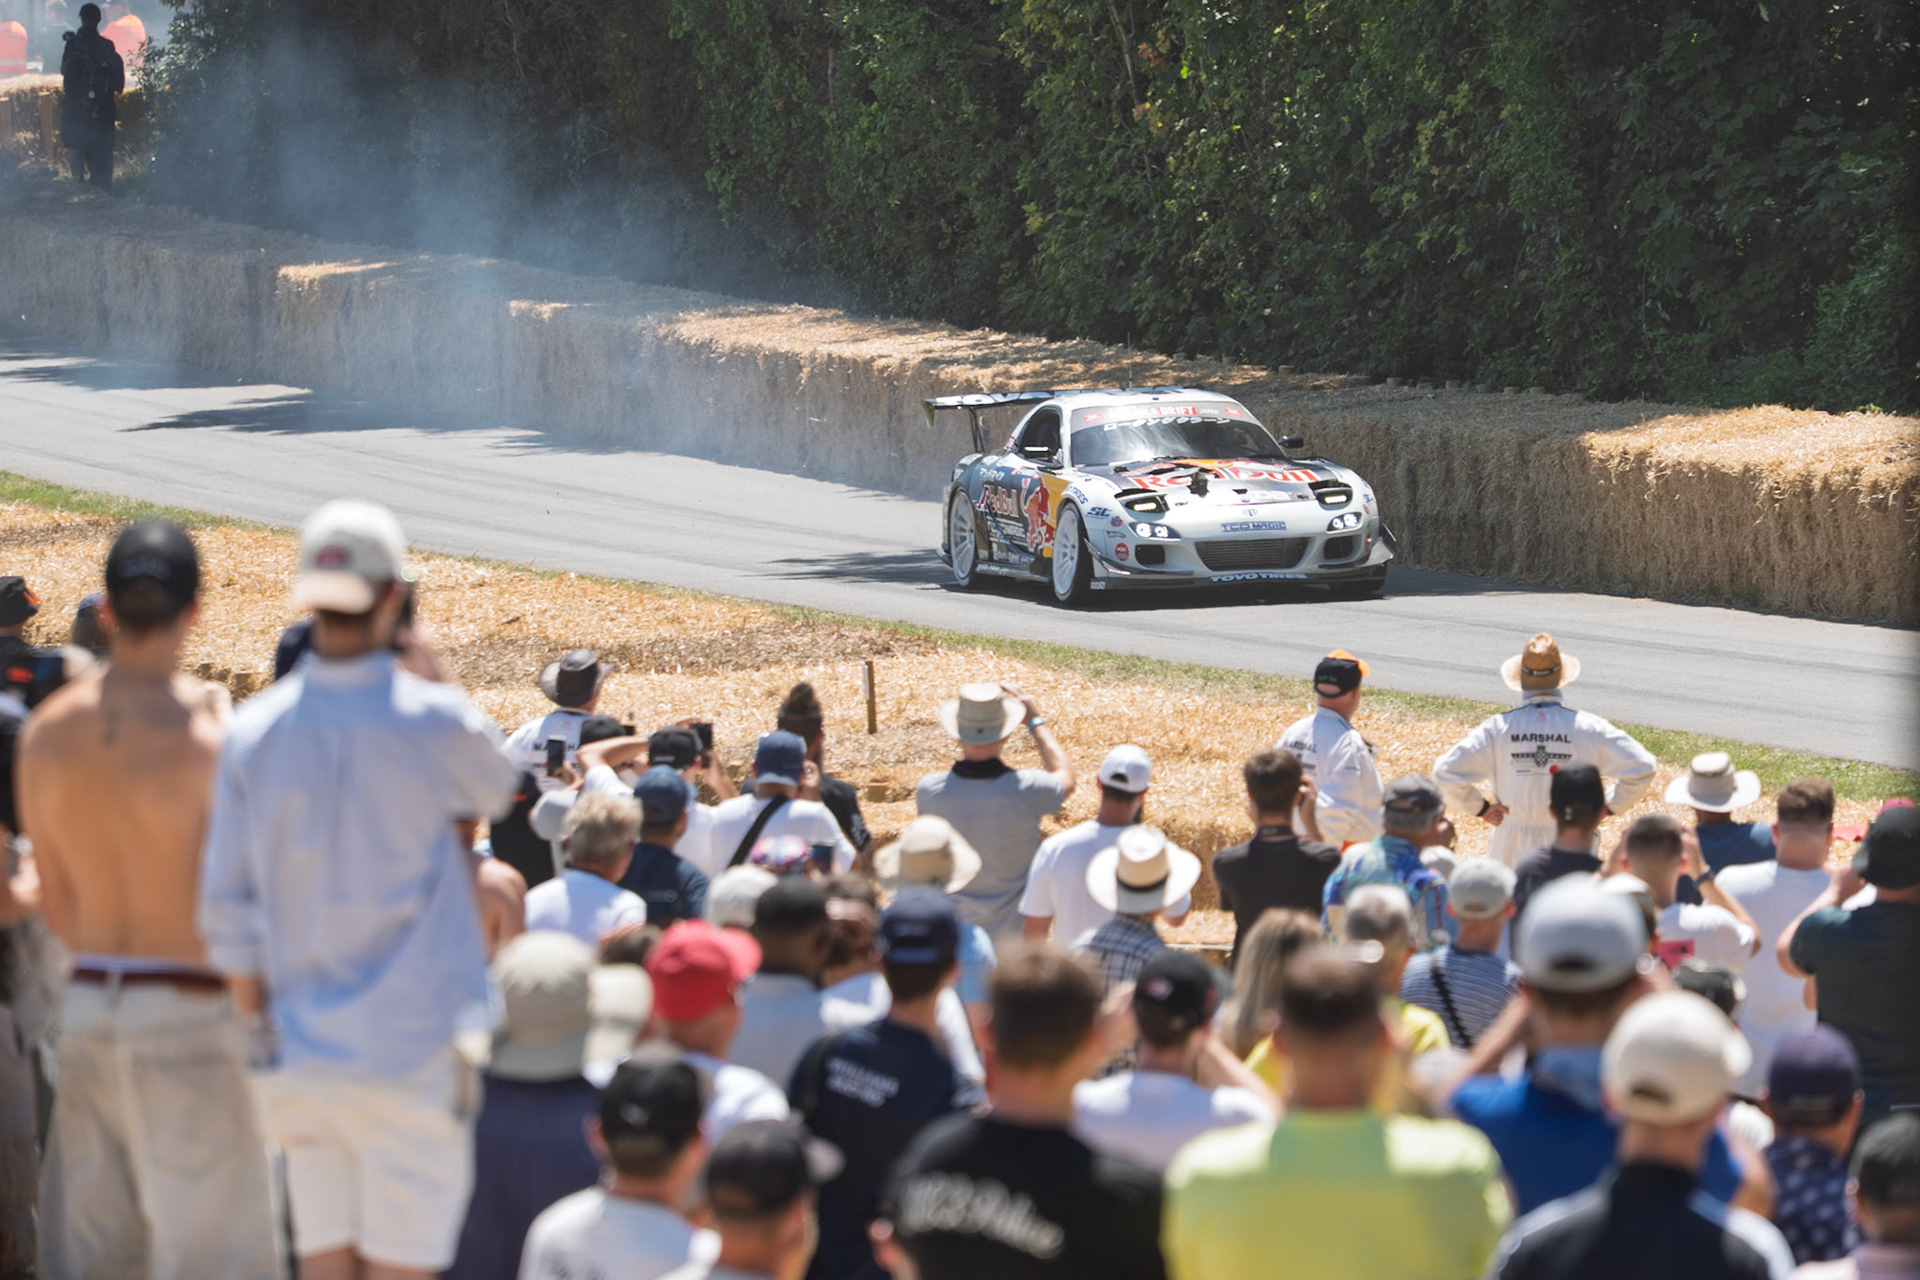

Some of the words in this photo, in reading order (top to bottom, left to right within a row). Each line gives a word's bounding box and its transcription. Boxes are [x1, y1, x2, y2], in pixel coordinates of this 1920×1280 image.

[1160, 405, 1194, 416] DRIFT
[1211, 573, 1258, 583] TOYO
[1511, 733, 1572, 743] MARSHAL
